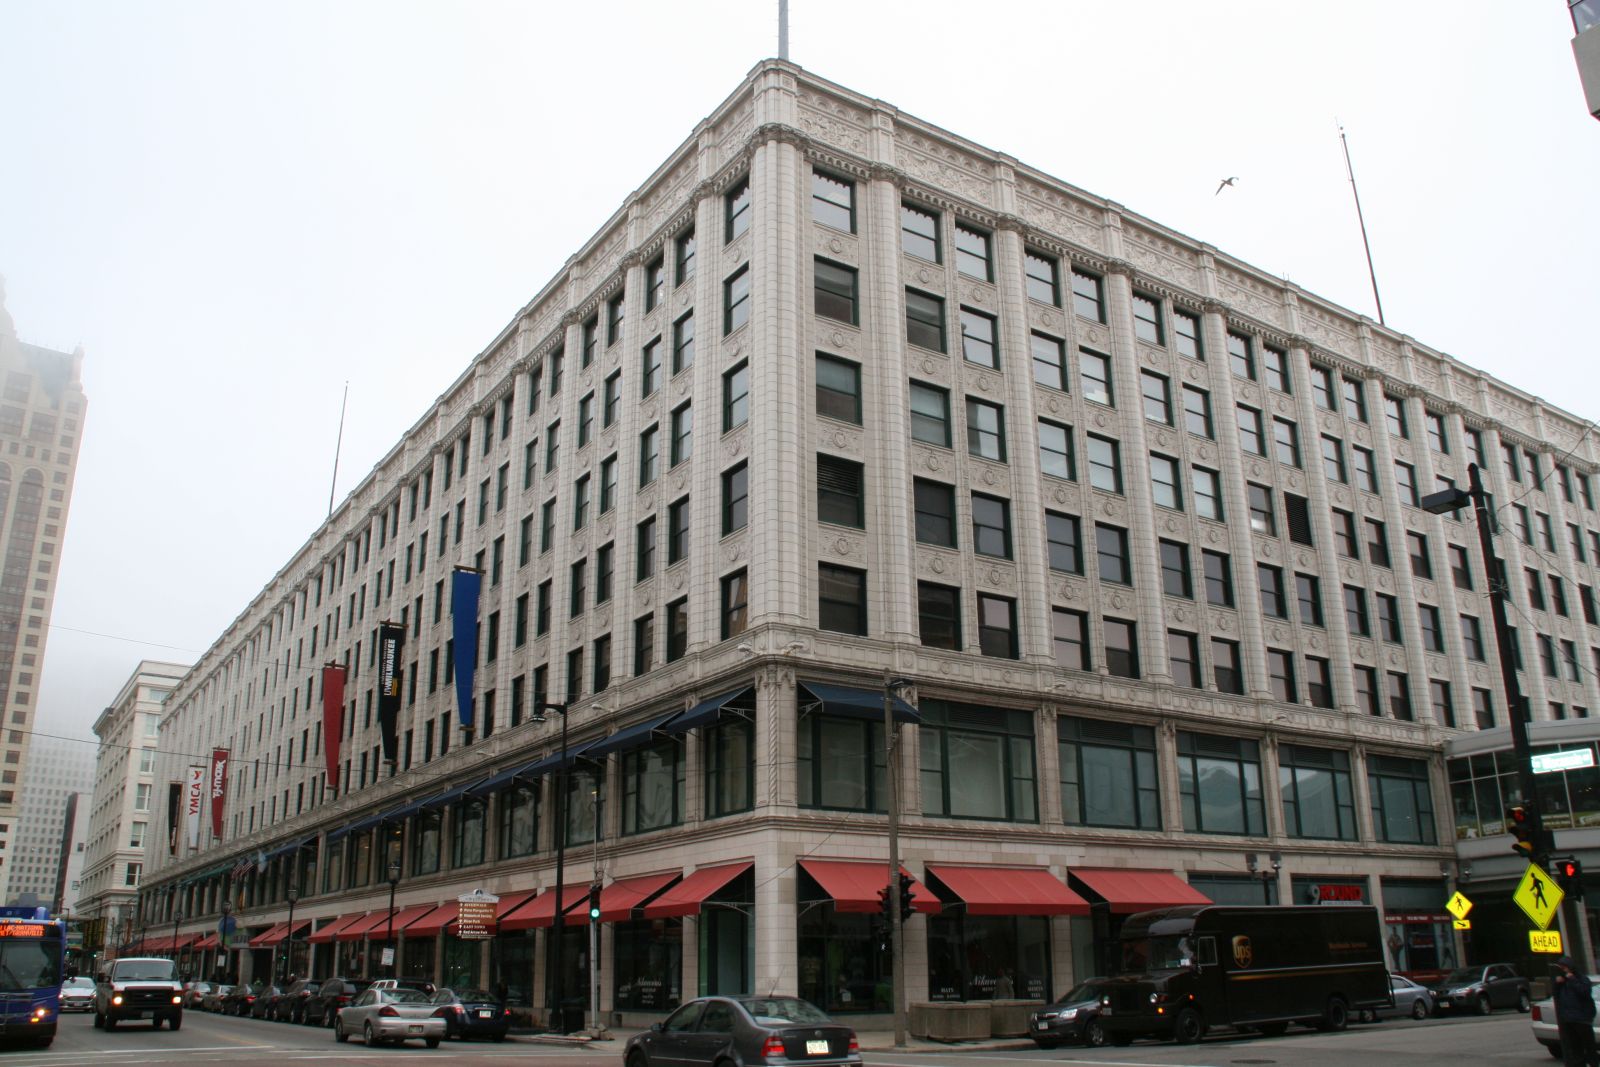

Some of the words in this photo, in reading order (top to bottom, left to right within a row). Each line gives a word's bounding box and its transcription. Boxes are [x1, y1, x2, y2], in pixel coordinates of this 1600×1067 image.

[188, 782, 202, 816] YMCA
[1533, 936, 1558, 948] AHEAD
[1233, 943, 1251, 961] ups
